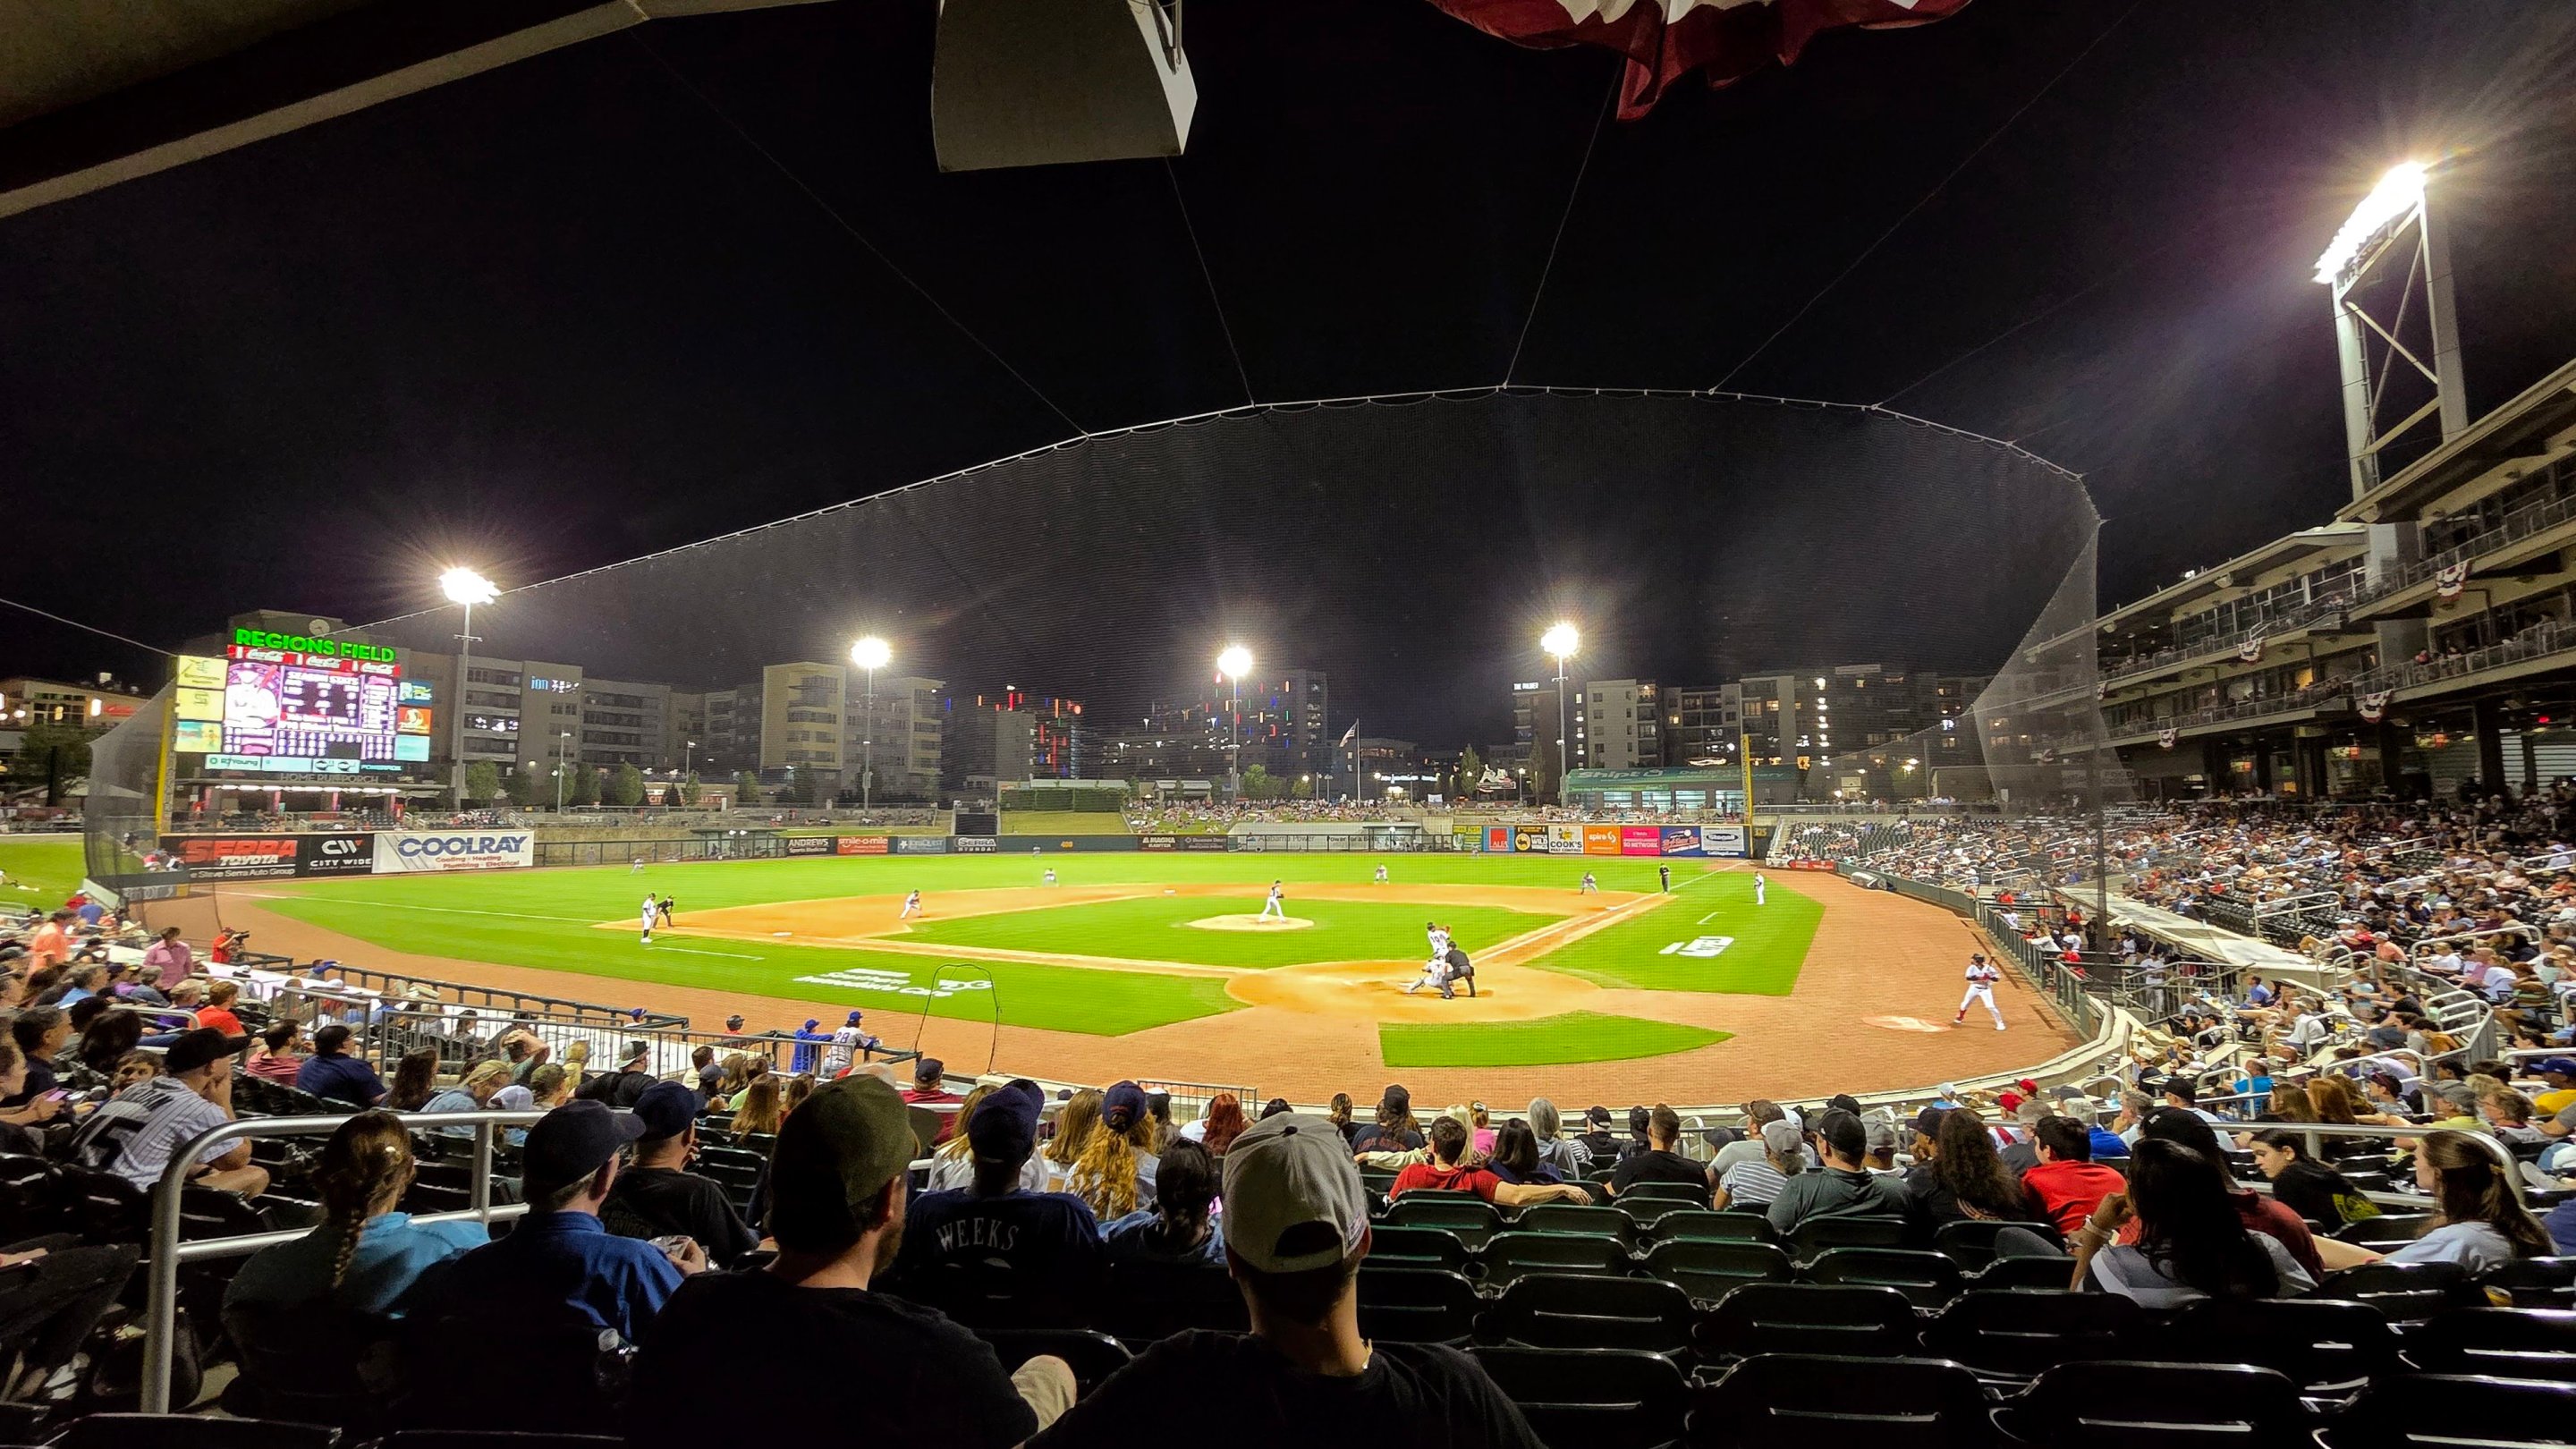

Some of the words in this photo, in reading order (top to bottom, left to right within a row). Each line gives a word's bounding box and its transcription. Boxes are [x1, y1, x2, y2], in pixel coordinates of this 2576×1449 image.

[235, 628, 336, 656] REGIONS
[340, 641, 396, 663] FIELD
[530, 675, 549, 691] ion
[280, 772, 315, 782] HOME
[343, 775, 379, 784] PORCH
[1578, 770, 1641, 779] Shipt
[788, 838, 829, 847] ANDREWS
[958, 837, 996, 846] SERRA
[1589, 833, 1607, 841] spire
[180, 839, 299, 863] SERRA
[397, 835, 529, 857] COOLRAY
[219, 855, 279, 866] TOYOTA
[309, 859, 339, 867] CITY
[198, 869, 224, 878] Steve
[225, 869, 249, 877] Serra
[249, 868, 268, 877] Auto
[269, 868, 296, 877] Group
[836, 1031, 851, 1044] 28
[936, 1216, 1021, 1252] WEEKS
